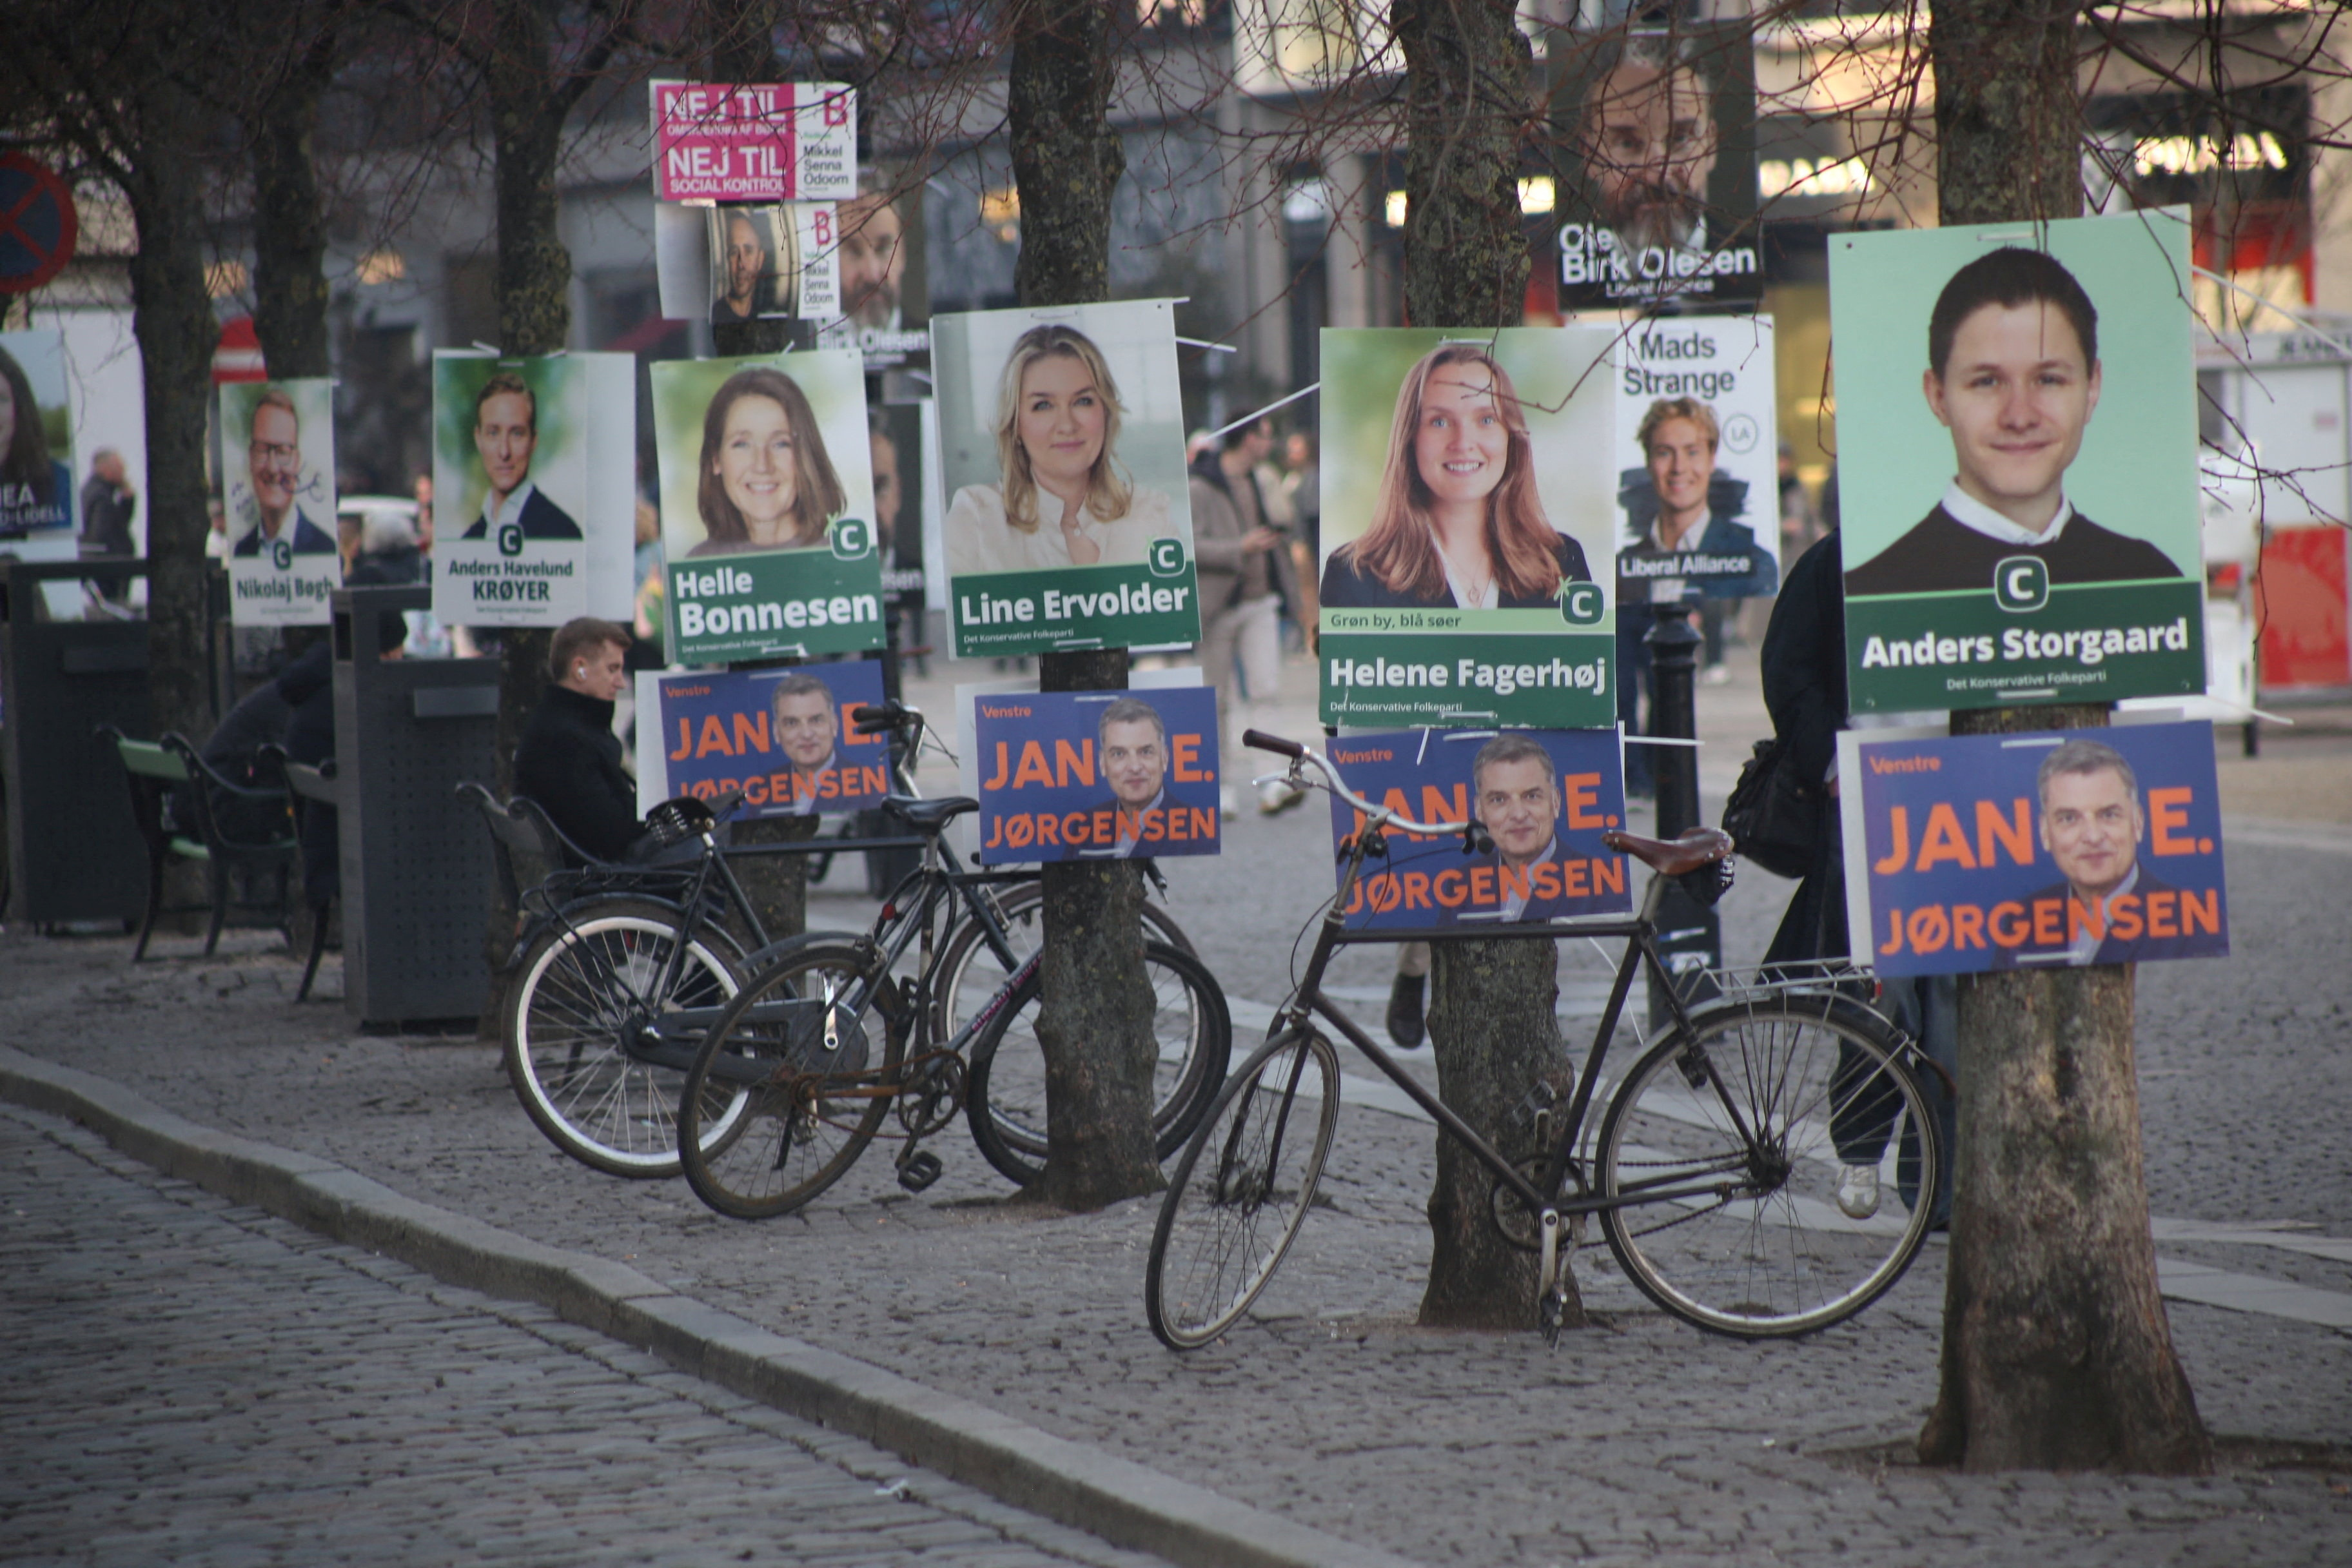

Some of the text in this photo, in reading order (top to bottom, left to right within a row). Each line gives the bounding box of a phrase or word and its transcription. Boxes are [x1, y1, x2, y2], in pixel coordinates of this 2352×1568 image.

[664, 91, 786, 121] NEJ TIL
[824, 91, 848, 126] B
[667, 145, 787, 177] NEJ TIL
[804, 142, 843, 157] Mikkel
[803, 173, 848, 185] Odoom
[804, 160, 841, 171] Senna
[670, 178, 786, 193] SOCIAL KONTROL
[814, 210, 830, 245] B
[1562, 247, 1757, 284] Birk Olesen
[1640, 332, 1716, 360] Mads
[1624, 368, 1735, 400] Strange
[1732, 426, 1750, 442] LA
[0, 482, 35, 508] EA
[839, 525, 860, 551] C
[449, 559, 573, 576] Anders Havelund
[1157, 545, 1176, 568] C
[1621, 553, 1750, 577] Liberal Alliance
[237, 576, 333, 602] Nikolaj Bøgh
[473, 580, 550, 601] KRØYER
[676, 567, 753, 598] Helle
[2007, 567, 2034, 600] C
[679, 594, 877, 637] Bonnesen
[961, 582, 1189, 625] Line Ervolder
[1571, 591, 1593, 618] C
[1330, 612, 1461, 629] Grøn by, blå søer
[964, 628, 1074, 643] Det Konservative Folkeparti
[1862, 617, 2188, 669] Anders Storgaard
[1330, 657, 1606, 696] Helene Fagerhøj
[1946, 669, 2107, 691] Det Konservative Folkeparti
[665, 685, 710, 698] Venstre
[981, 704, 1032, 718] Venstre
[1330, 701, 1462, 712] Det Konservative Folkeparti
[669, 701, 883, 761] JAN E.
[983, 733, 1215, 791] JAN E.
[1335, 749, 1393, 764] Venstre
[1870, 756, 1941, 774] Venstre
[1565, 772, 1619, 830] E.
[985, 807, 1216, 848] JØRGENSEN
[1874, 787, 2214, 875] JAN E.
[1345, 857, 1624, 914] JØRGENSEN
[1879, 888, 2220, 955] JØRGENSEN
